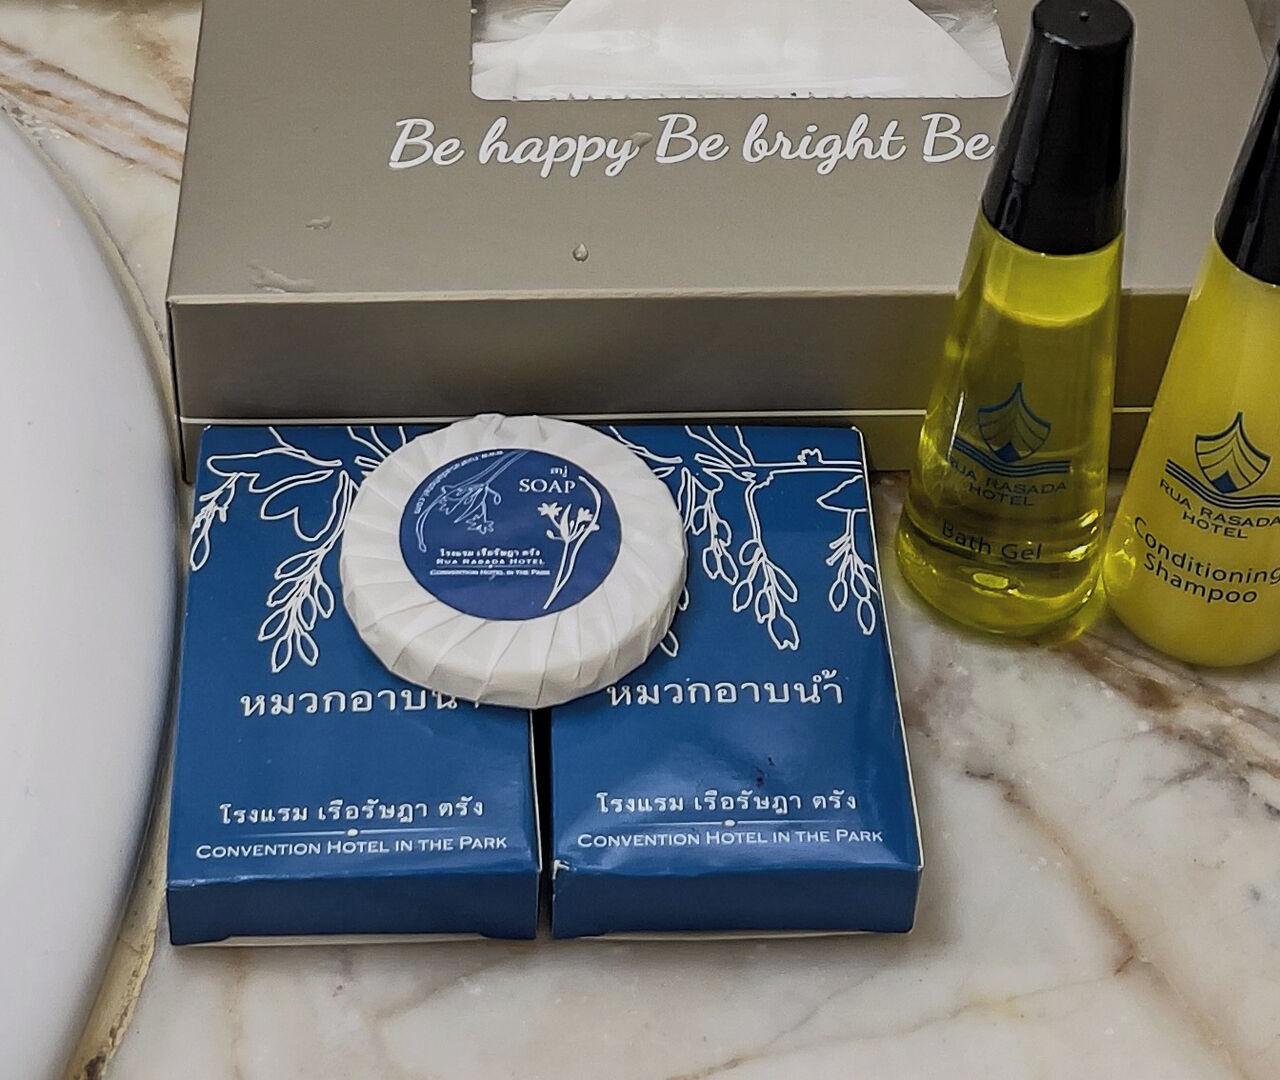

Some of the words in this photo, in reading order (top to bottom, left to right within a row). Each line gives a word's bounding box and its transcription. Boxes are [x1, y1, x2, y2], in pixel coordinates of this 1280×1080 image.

[388, 117, 466, 169] Be
[478, 116, 640, 178] happy
[655, 113, 730, 164] Be
[742, 113, 907, 175] bright
[921, 113, 997, 163] Be
[518, 478, 576, 494] SOAP
[969, 482, 1035, 507] HOTEL
[985, 477, 1067, 495] RASADA
[1159, 478, 1192, 510] RUA
[1182, 511, 1249, 539] HOTEL
[942, 520, 991, 555] Bath
[1001, 543, 1042, 561] Gel
[1144, 552, 1258, 604] Shampoo
[605, 669, 845, 707] หมวกอาบน้ำ
[219, 803, 309, 825] โรงแรม
[438, 795, 485, 819] ตรัง
[595, 792, 684, 815] โรงแรม
[812, 788, 858, 811] ตรัง
[195, 842, 321, 860] CONVENTION
[326, 839, 390, 855] HOTEL
[395, 839, 414, 852] IN
[418, 838, 454, 852] THE
[459, 836, 508, 851] PARK
[577, 832, 701, 848] CONVENTION
[705, 830, 768, 845] HOTEL
[772, 830, 791, 843] IN
[795, 829, 831, 843] THE
[835, 828, 884, 843] PARK
